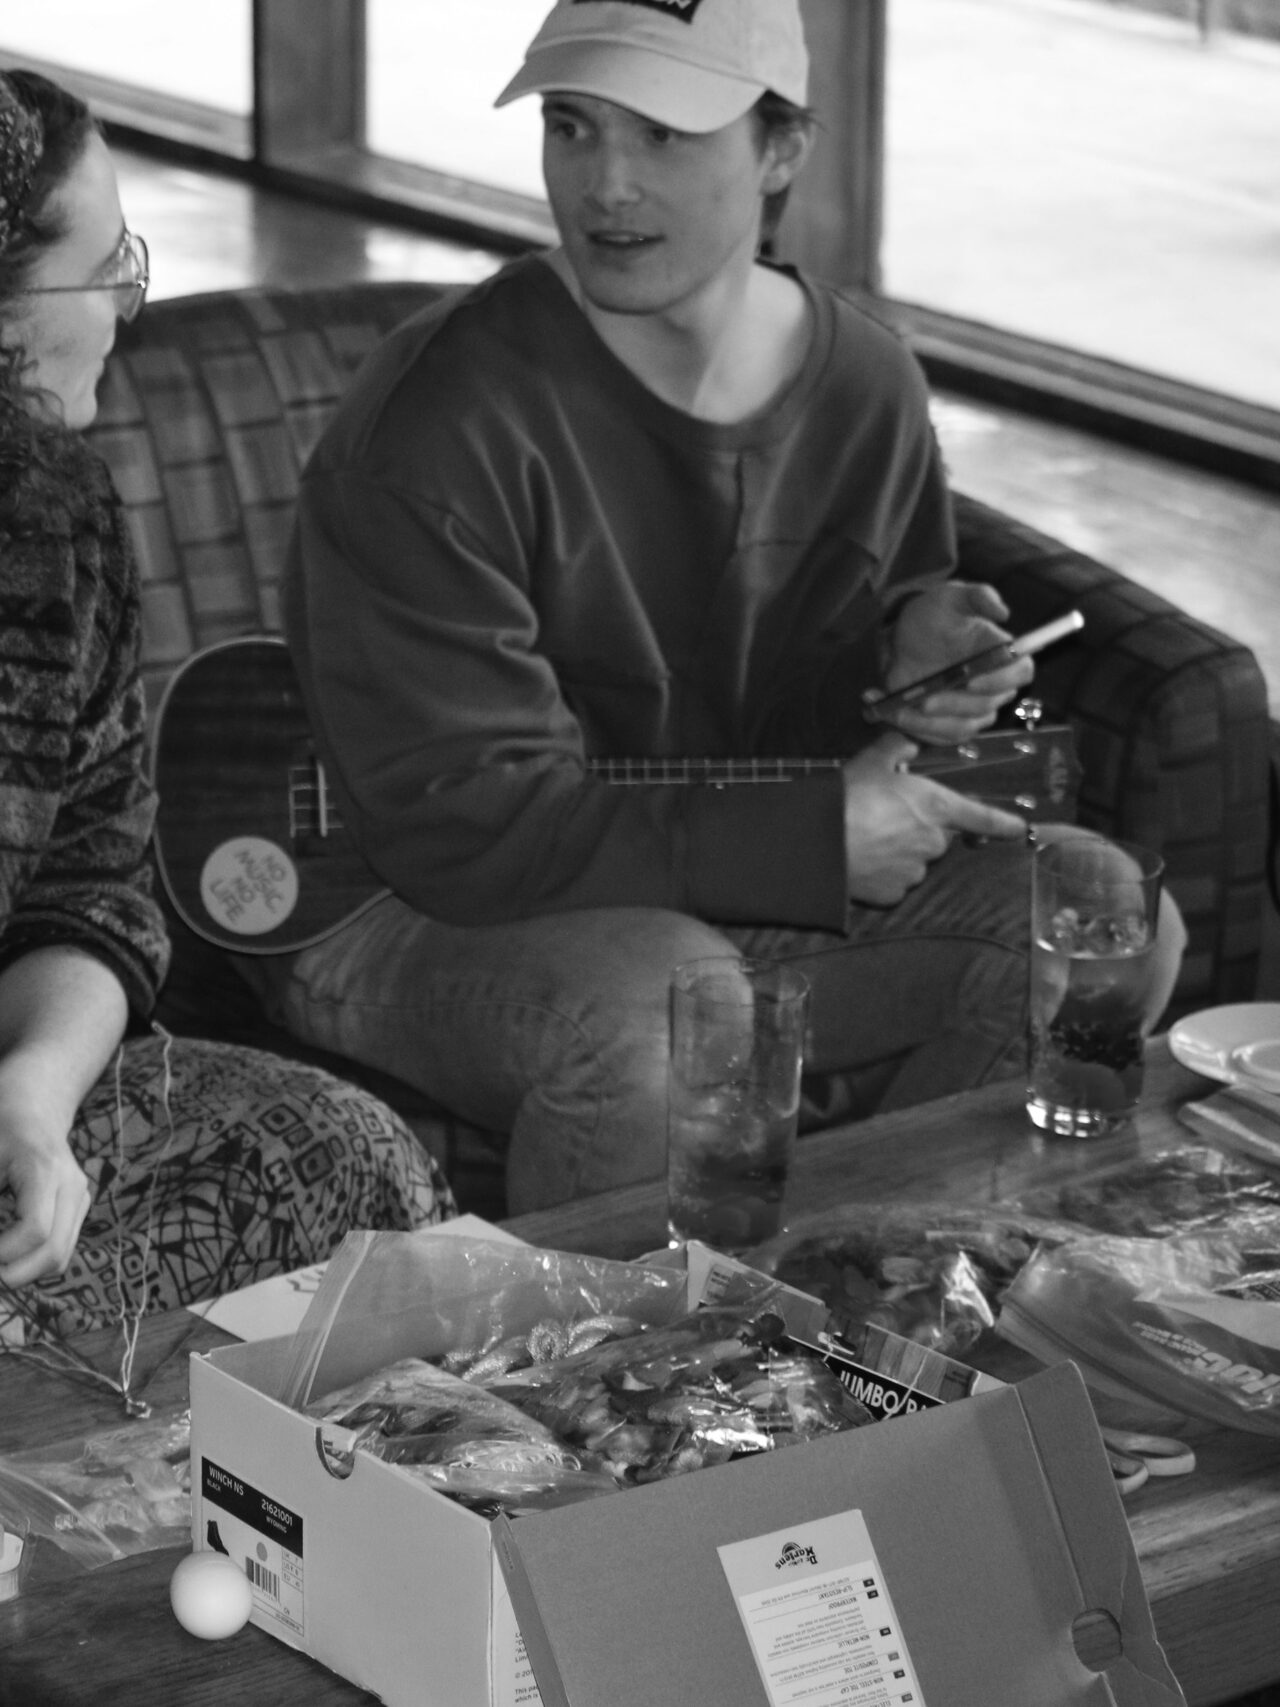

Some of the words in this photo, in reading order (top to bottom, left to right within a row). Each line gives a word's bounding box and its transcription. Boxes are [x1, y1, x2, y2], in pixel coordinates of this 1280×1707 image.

[234, 849, 283, 914] MUSIC
[263, 855, 286, 882] NO
[209, 878, 244, 923] LIFE
[231, 876, 255, 904] NO
[206, 1478, 221, 1492] BLACK
[209, 1465, 232, 1489] WINCH
[234, 1482, 244, 1496] NS
[261, 1499, 293, 1527] 21621001
[266, 1515, 287, 1534] WYOMING
[775, 1546, 815, 1570] Martens
